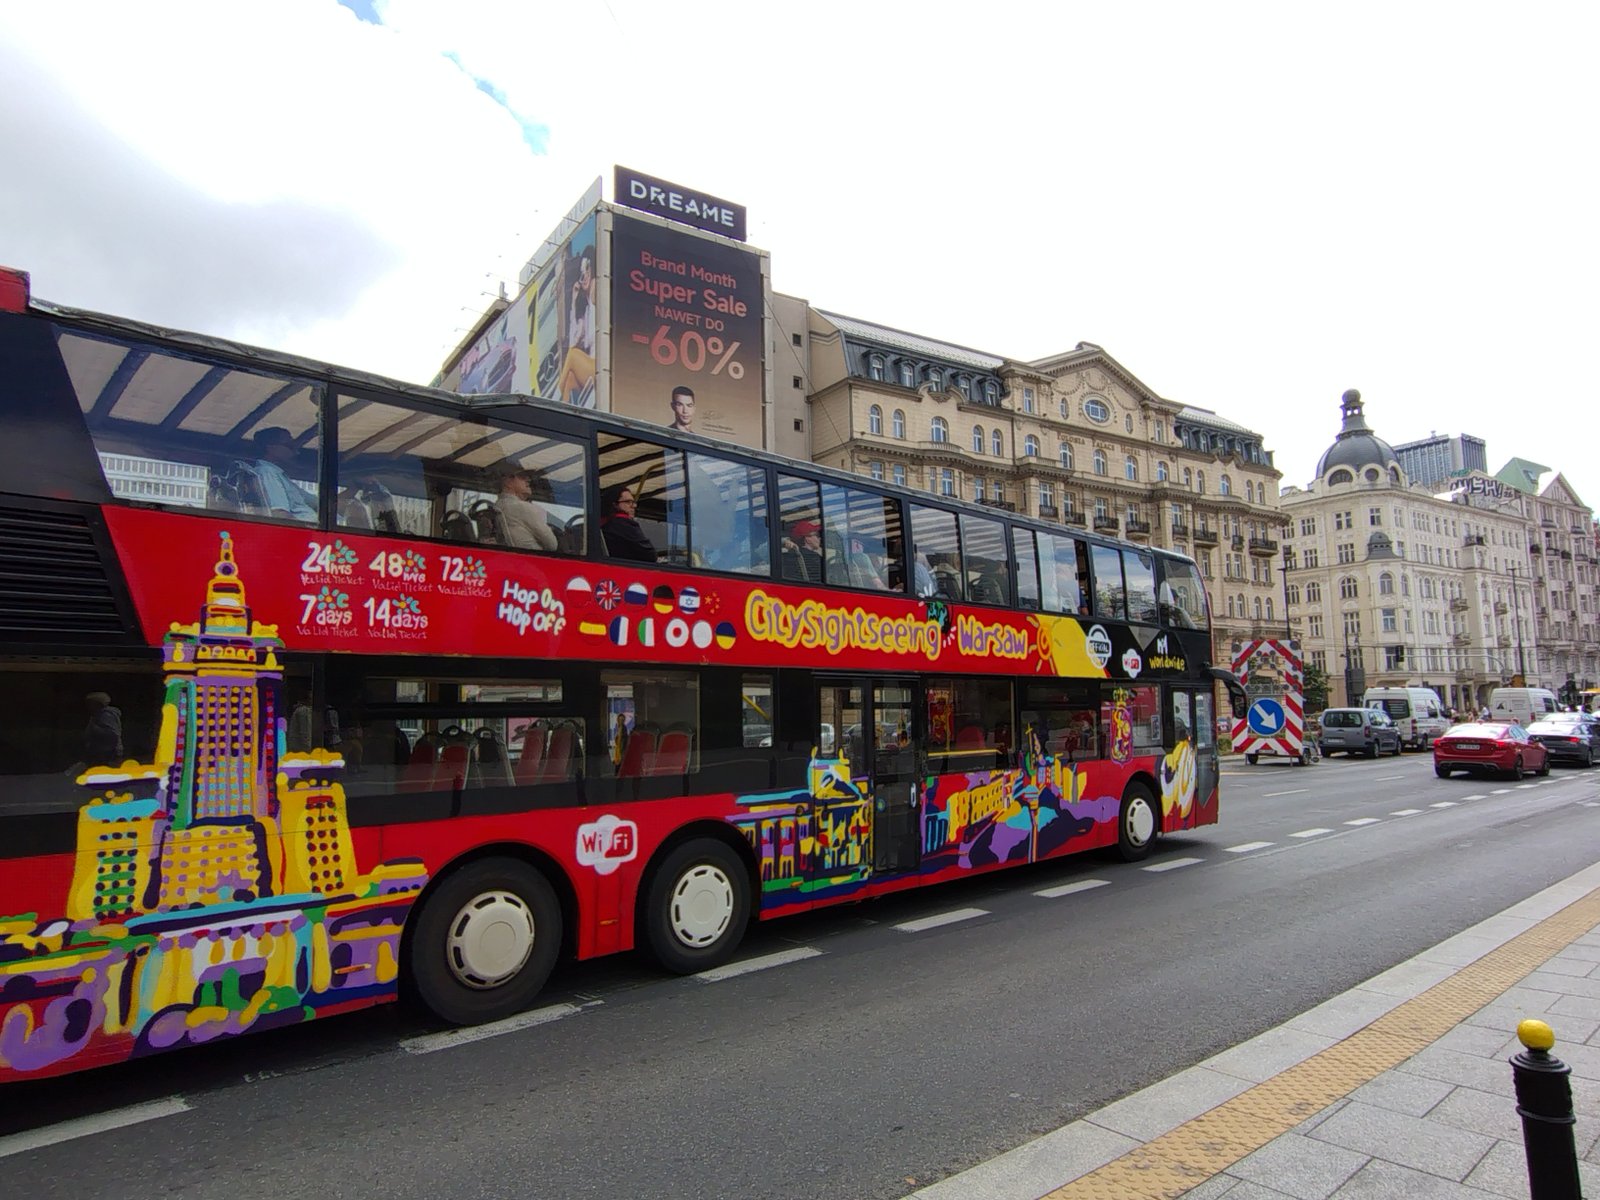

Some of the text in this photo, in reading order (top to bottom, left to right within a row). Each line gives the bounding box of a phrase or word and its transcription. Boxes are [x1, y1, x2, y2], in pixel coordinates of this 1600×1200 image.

[631, 180, 734, 227] DREAME
[641, 251, 737, 289] Brand Month
[629, 270, 747, 317] Super Sale
[655, 305, 724, 331] NAWET DO
[632, 325, 744, 379] -60%
[302, 542, 331, 573] 24
[369, 551, 403, 578] 48
[440, 556, 464, 581] 72
[300, 594, 352, 626] 7 days
[363, 597, 428, 630] 14 days
[503, 579, 565, 616] Hop On
[499, 602, 531, 636] Hop
[957, 616, 1027, 659] Warsaw
